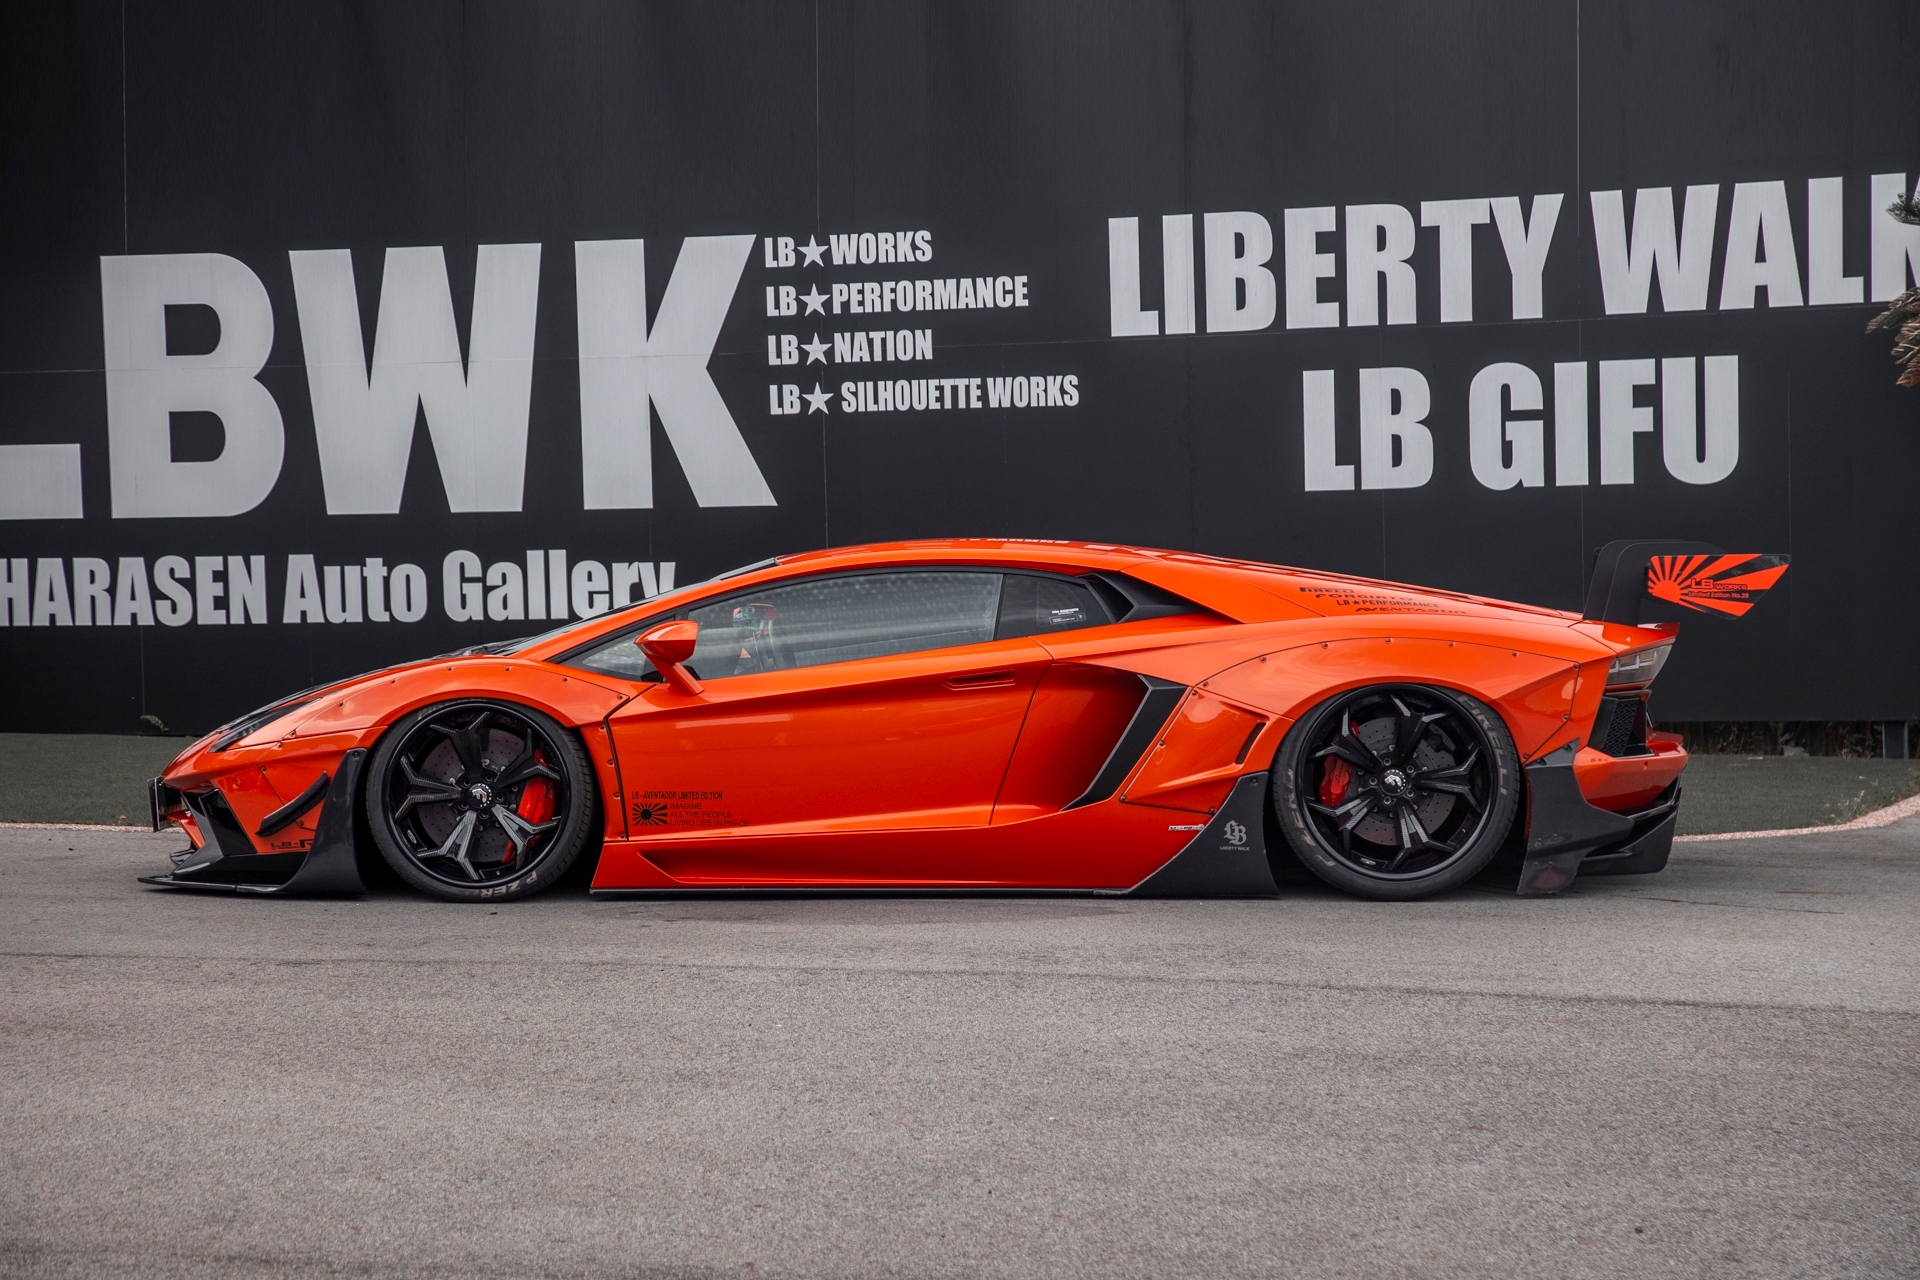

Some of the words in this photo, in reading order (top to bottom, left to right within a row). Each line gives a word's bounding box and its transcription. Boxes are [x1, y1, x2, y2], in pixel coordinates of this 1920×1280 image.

[1108, 193, 1564, 337] LIBERTY
[1590, 172, 1920, 315] WALK
[841, 377, 982, 412] SILHOUETTE
[987, 375, 1079, 409] WORKS
[1303, 367, 1433, 491] LB
[1469, 355, 1739, 490] GIFU
[283, 554, 427, 623] Auto
[643, 791, 676, 800] AVENTADOR
[678, 791, 699, 800] LIMITED
